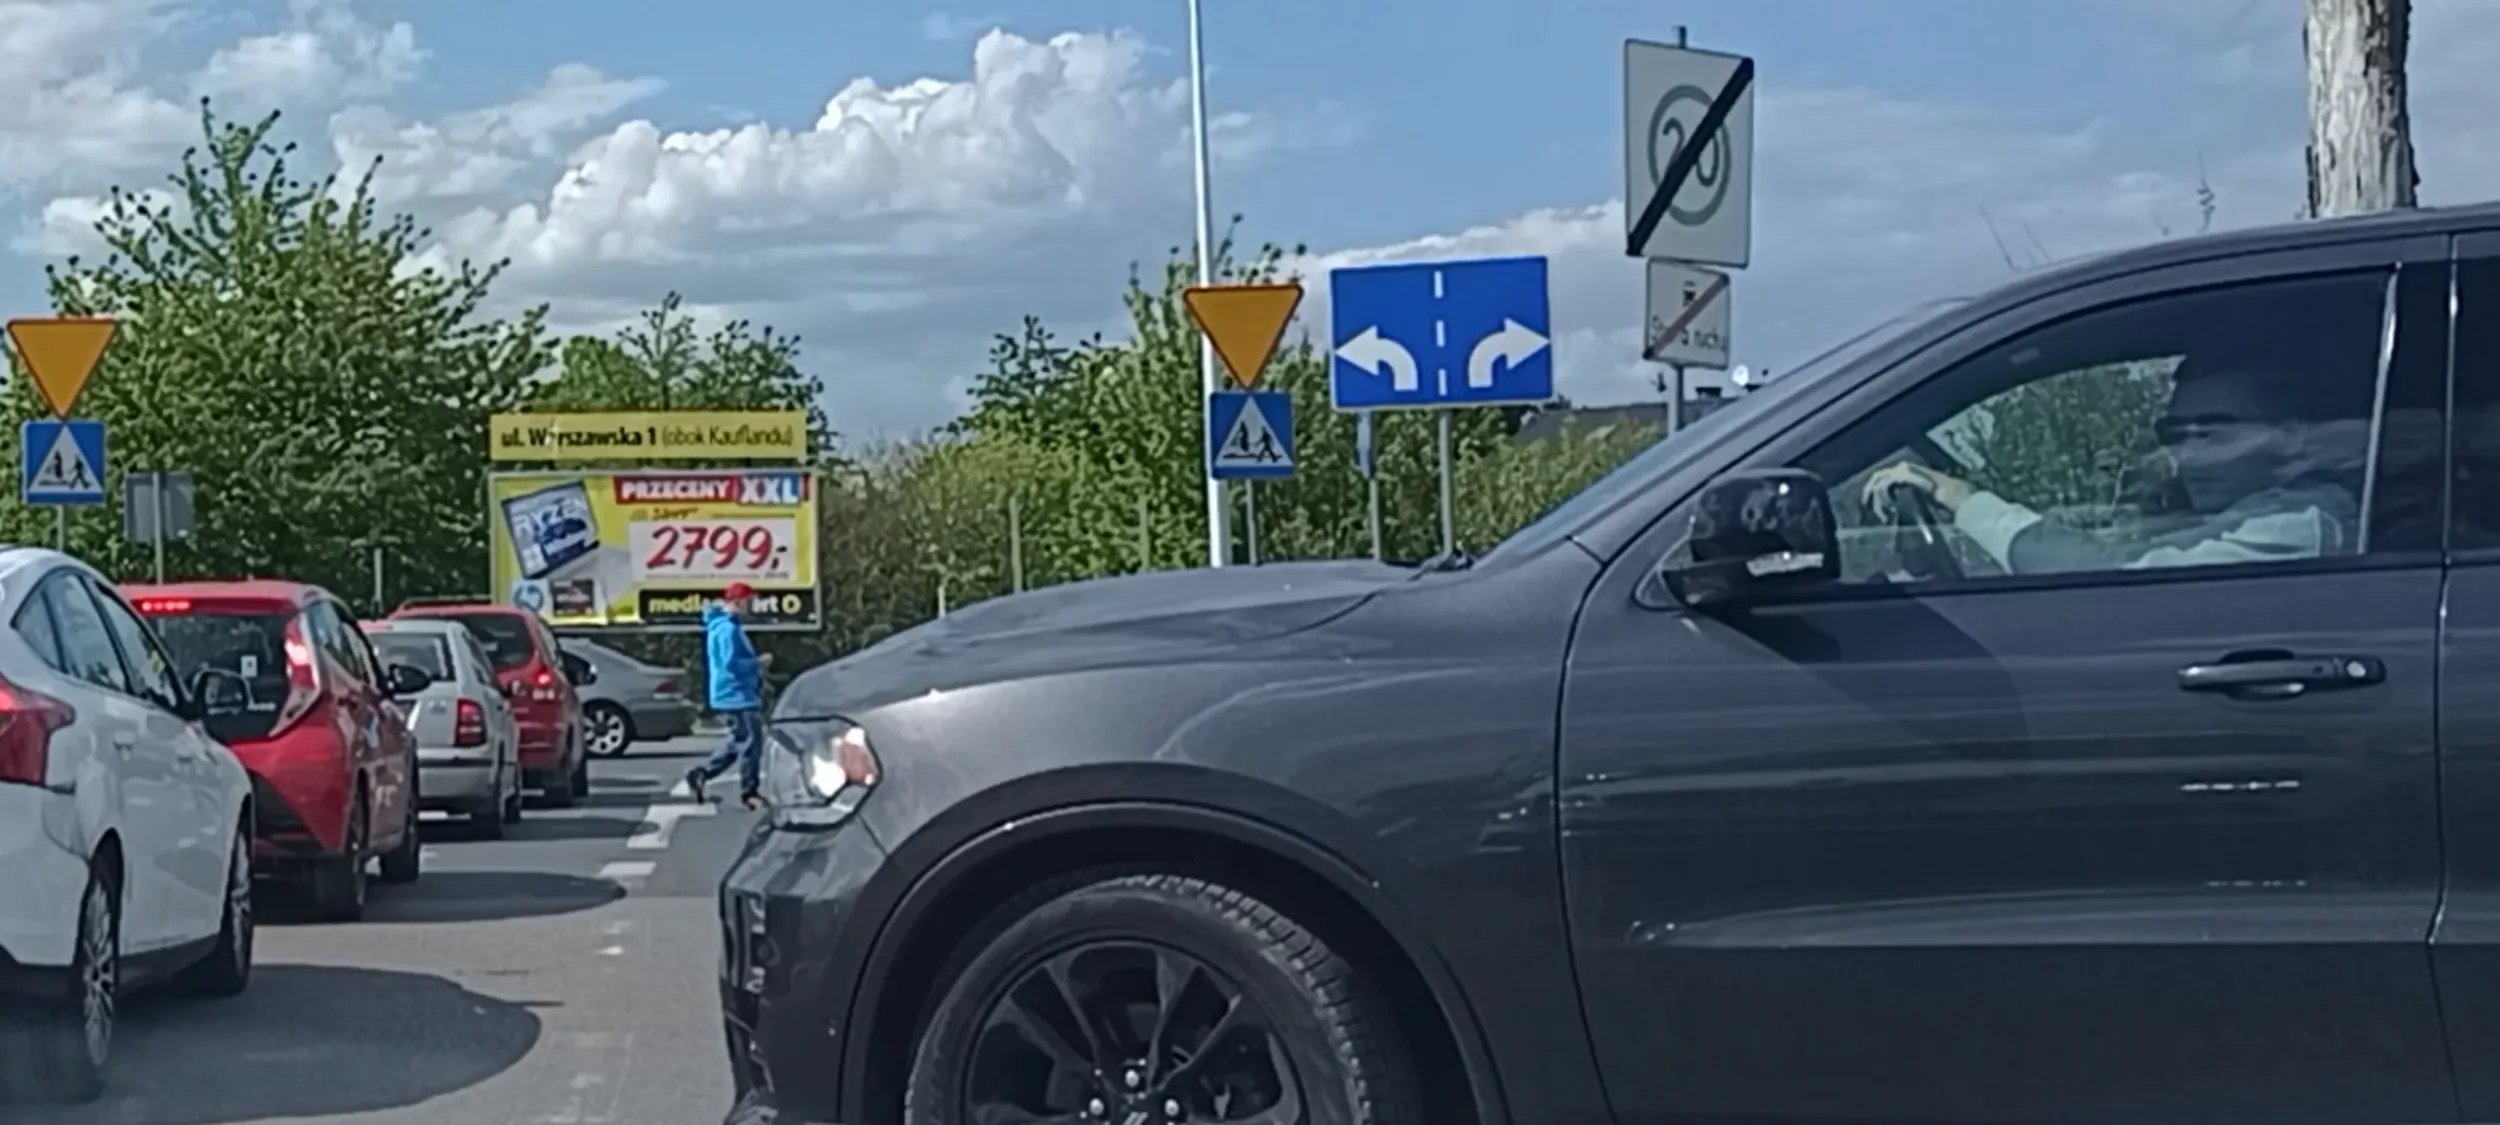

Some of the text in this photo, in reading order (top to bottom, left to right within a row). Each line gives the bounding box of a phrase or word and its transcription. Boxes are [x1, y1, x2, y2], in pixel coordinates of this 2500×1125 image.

[1661, 116, 1720, 188] 20
[502, 428, 525, 447] ul.
[647, 426, 656, 446] 1
[621, 477, 799, 504] PRZECENY XXL
